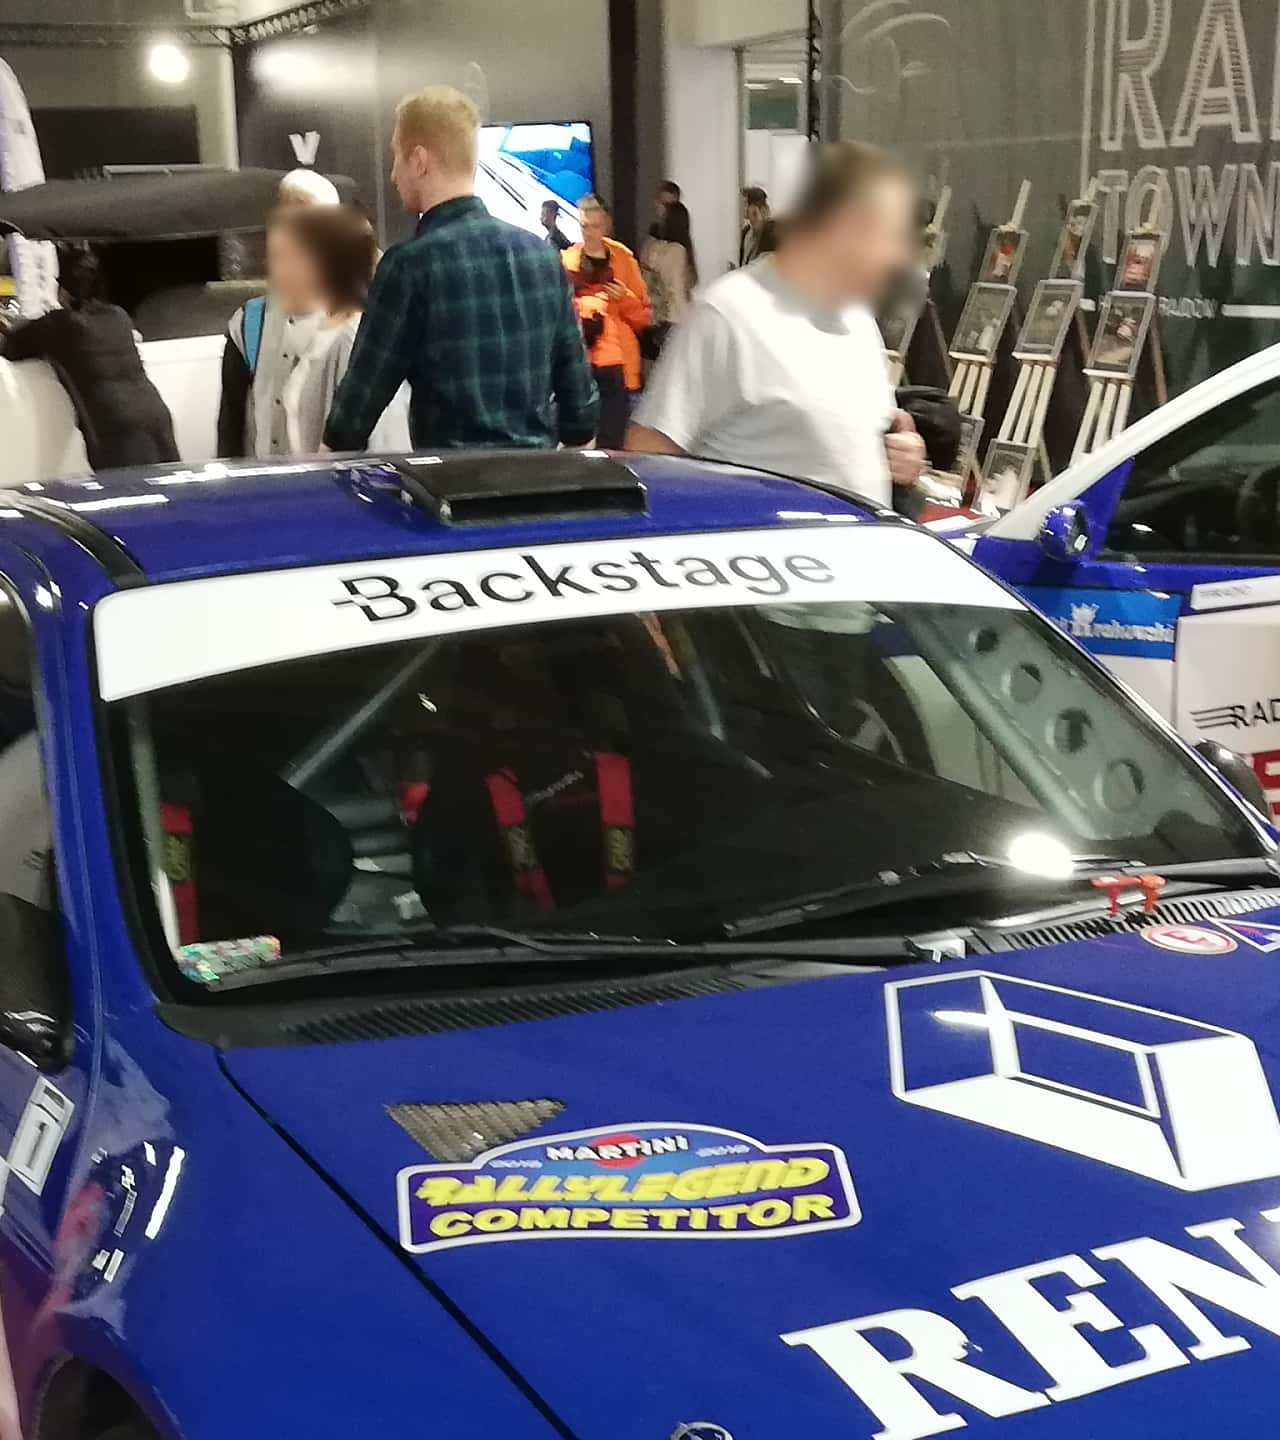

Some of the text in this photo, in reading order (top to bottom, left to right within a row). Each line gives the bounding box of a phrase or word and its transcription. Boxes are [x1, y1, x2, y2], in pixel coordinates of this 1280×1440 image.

[332, 548, 835, 624] Backstage
[544, 1134, 690, 1162] MARTINI
[417, 1157, 831, 1207] RALLYLEGEND
[428, 1194, 836, 1238] COMPETITOR
